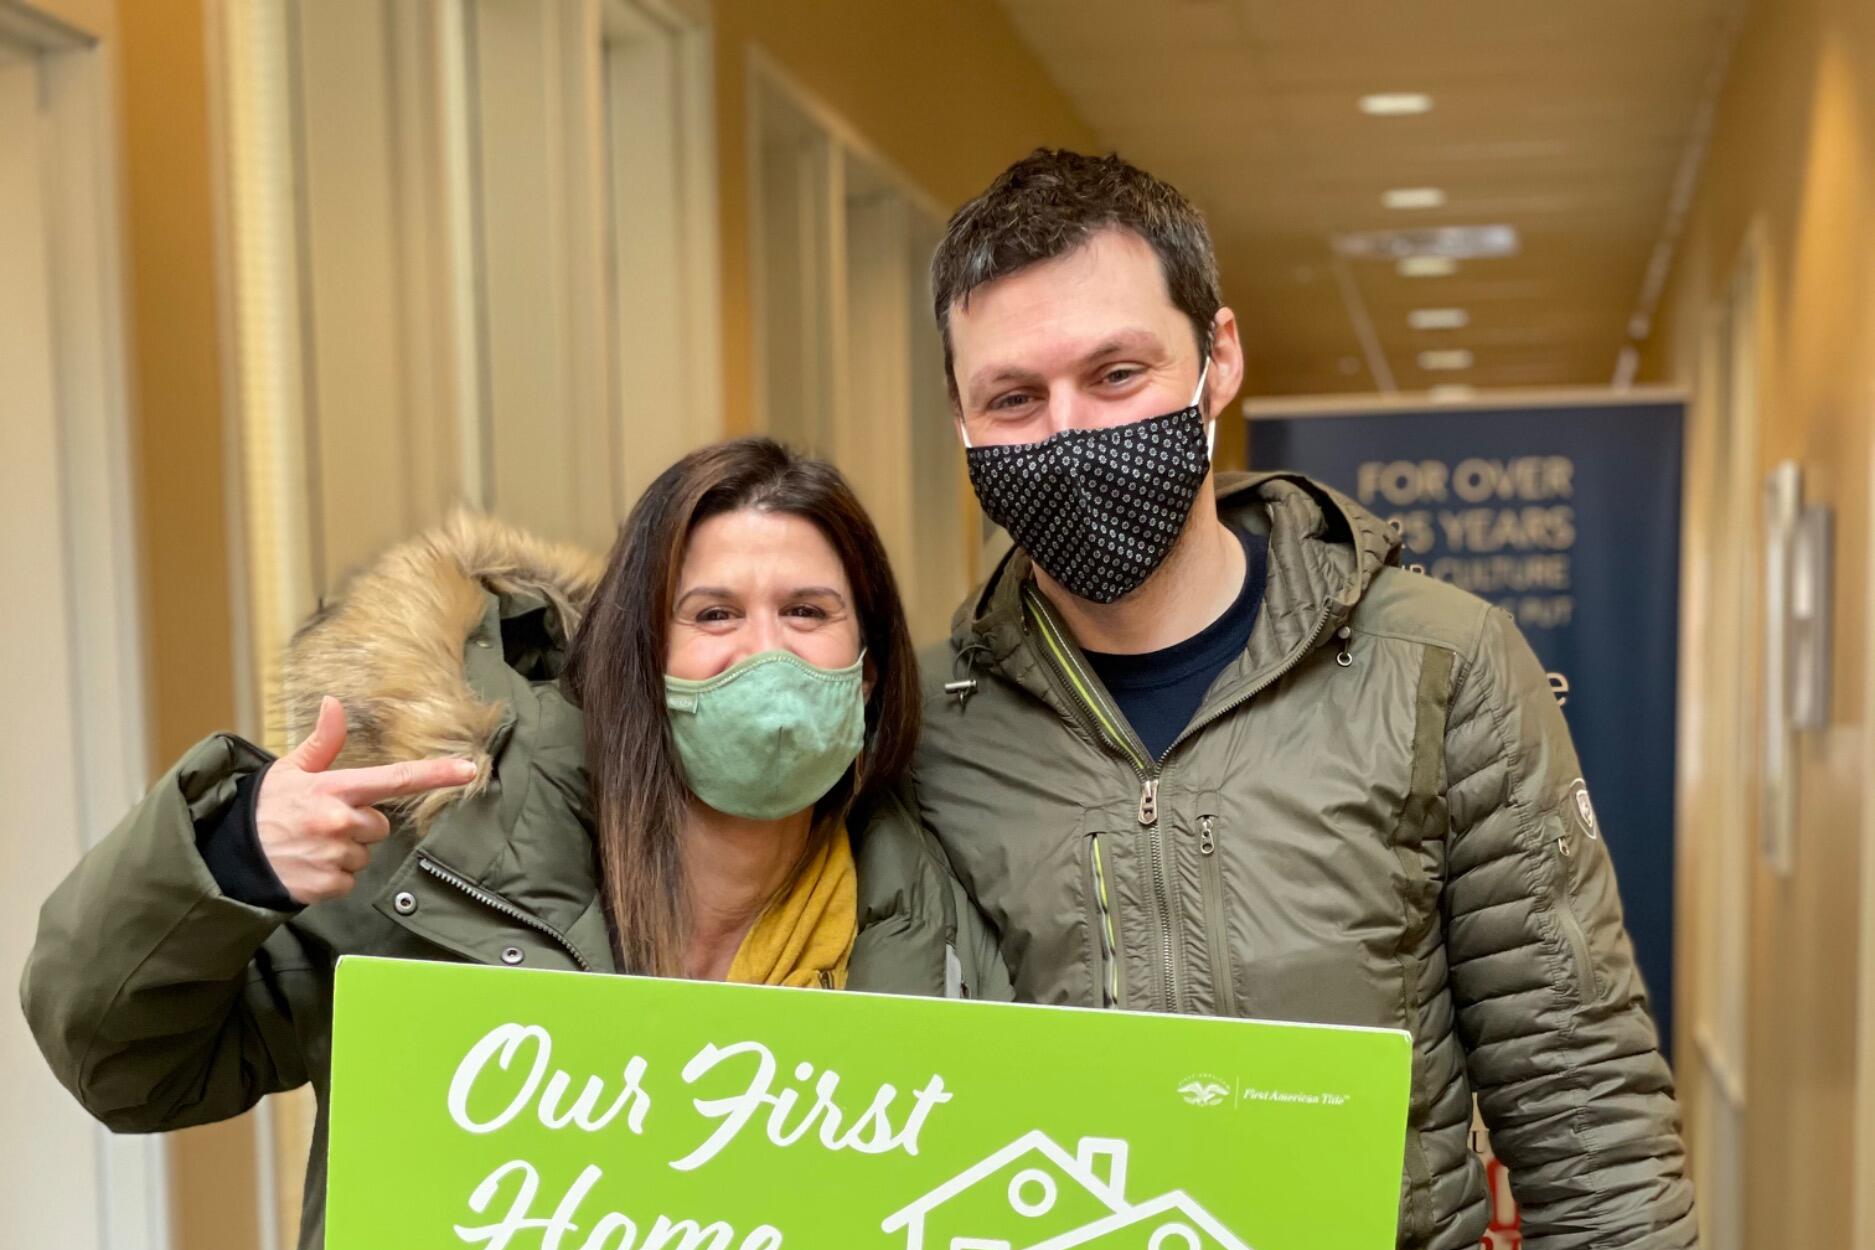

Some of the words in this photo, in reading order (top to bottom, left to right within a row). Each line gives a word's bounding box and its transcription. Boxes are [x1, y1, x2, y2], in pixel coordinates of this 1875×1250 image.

[1357, 461, 1448, 505] FOR
[1452, 455, 1575, 501] OVER
[1437, 505, 1576, 552] YEARS
[447, 1022, 651, 1134] Our
[668, 1040, 954, 1171] First
[1243, 1088, 1270, 1101] First
[1270, 1090, 1319, 1104] American
